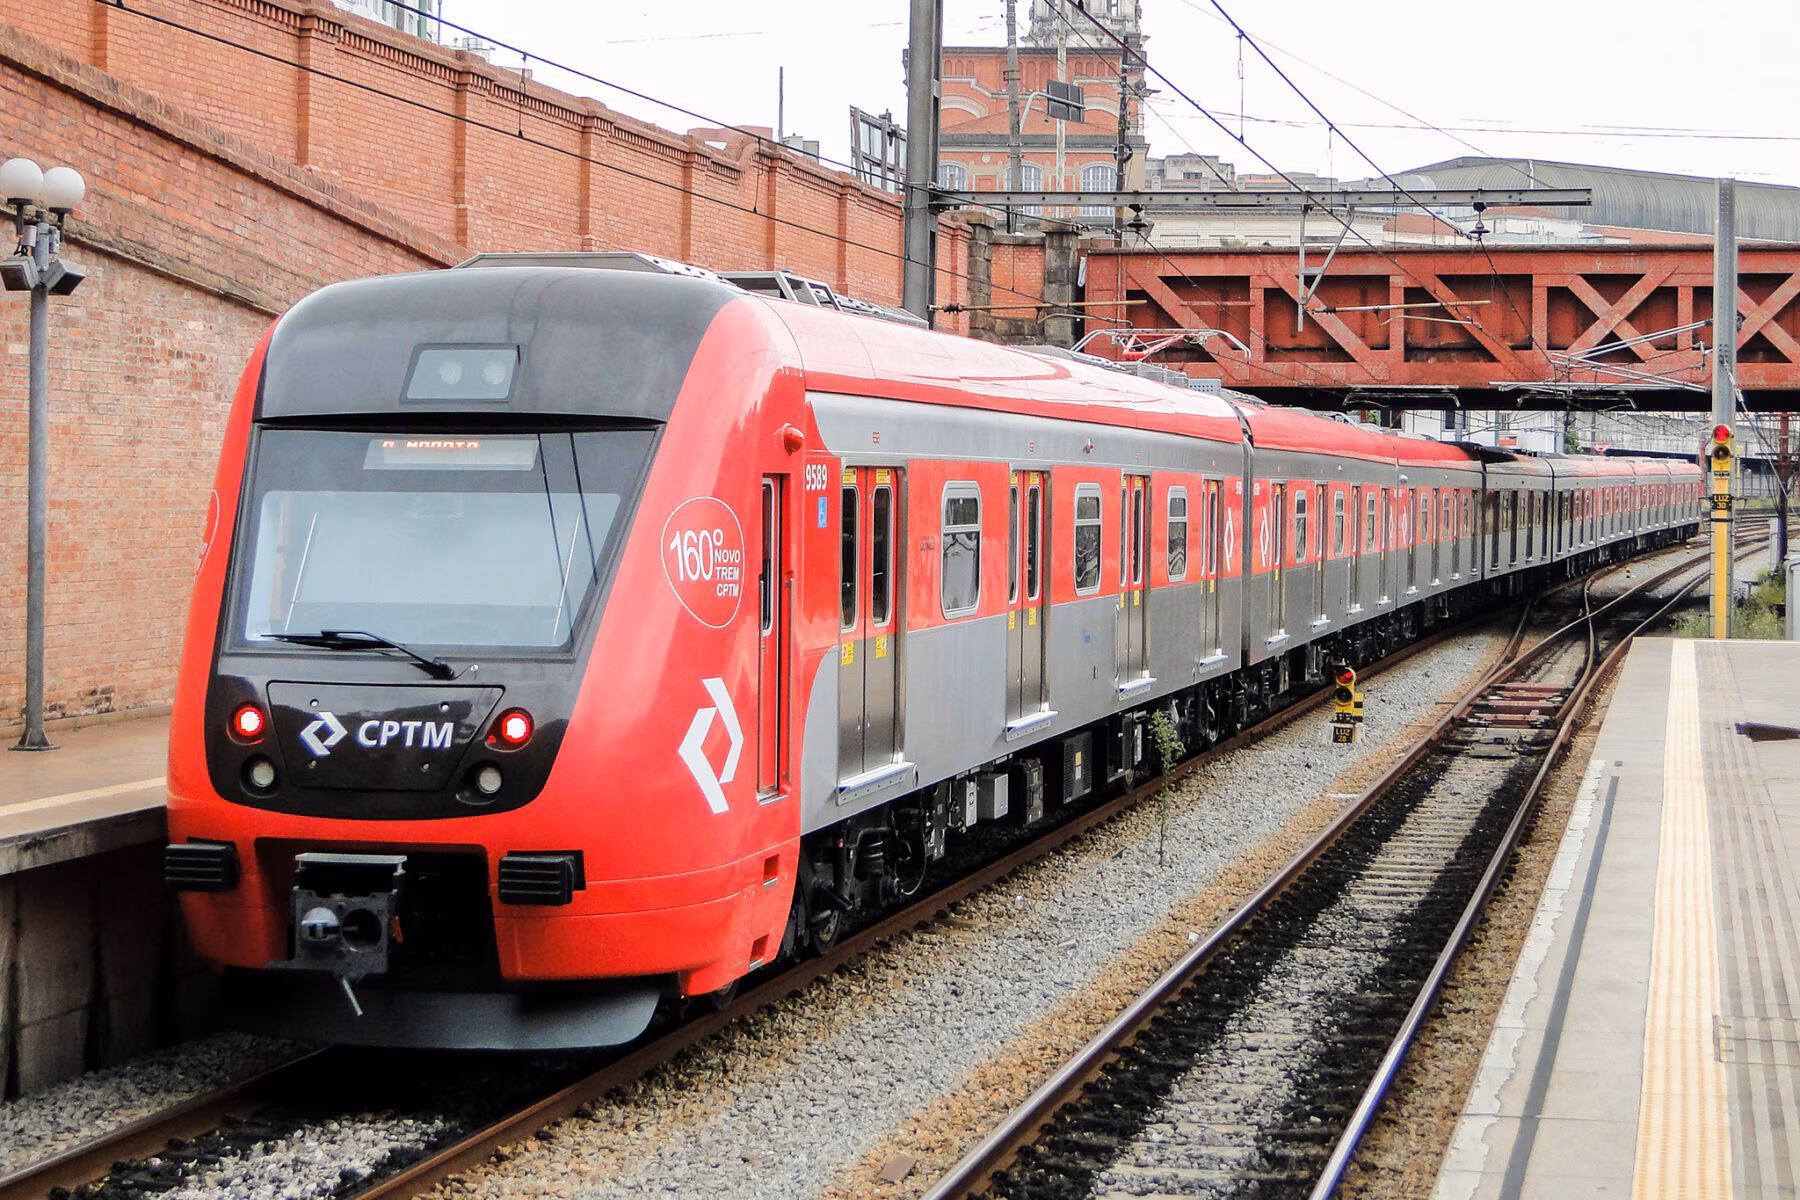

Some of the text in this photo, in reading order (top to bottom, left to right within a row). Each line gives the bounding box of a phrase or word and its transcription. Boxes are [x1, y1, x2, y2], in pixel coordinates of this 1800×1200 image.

[806, 464, 827, 490] 9589
[714, 550, 740, 563] NOVO
[715, 567, 739, 580] TREM
[716, 584, 738, 596] CPTM
[358, 720, 454, 747] CPTM
[1336, 728, 1351, 736] LUZ
